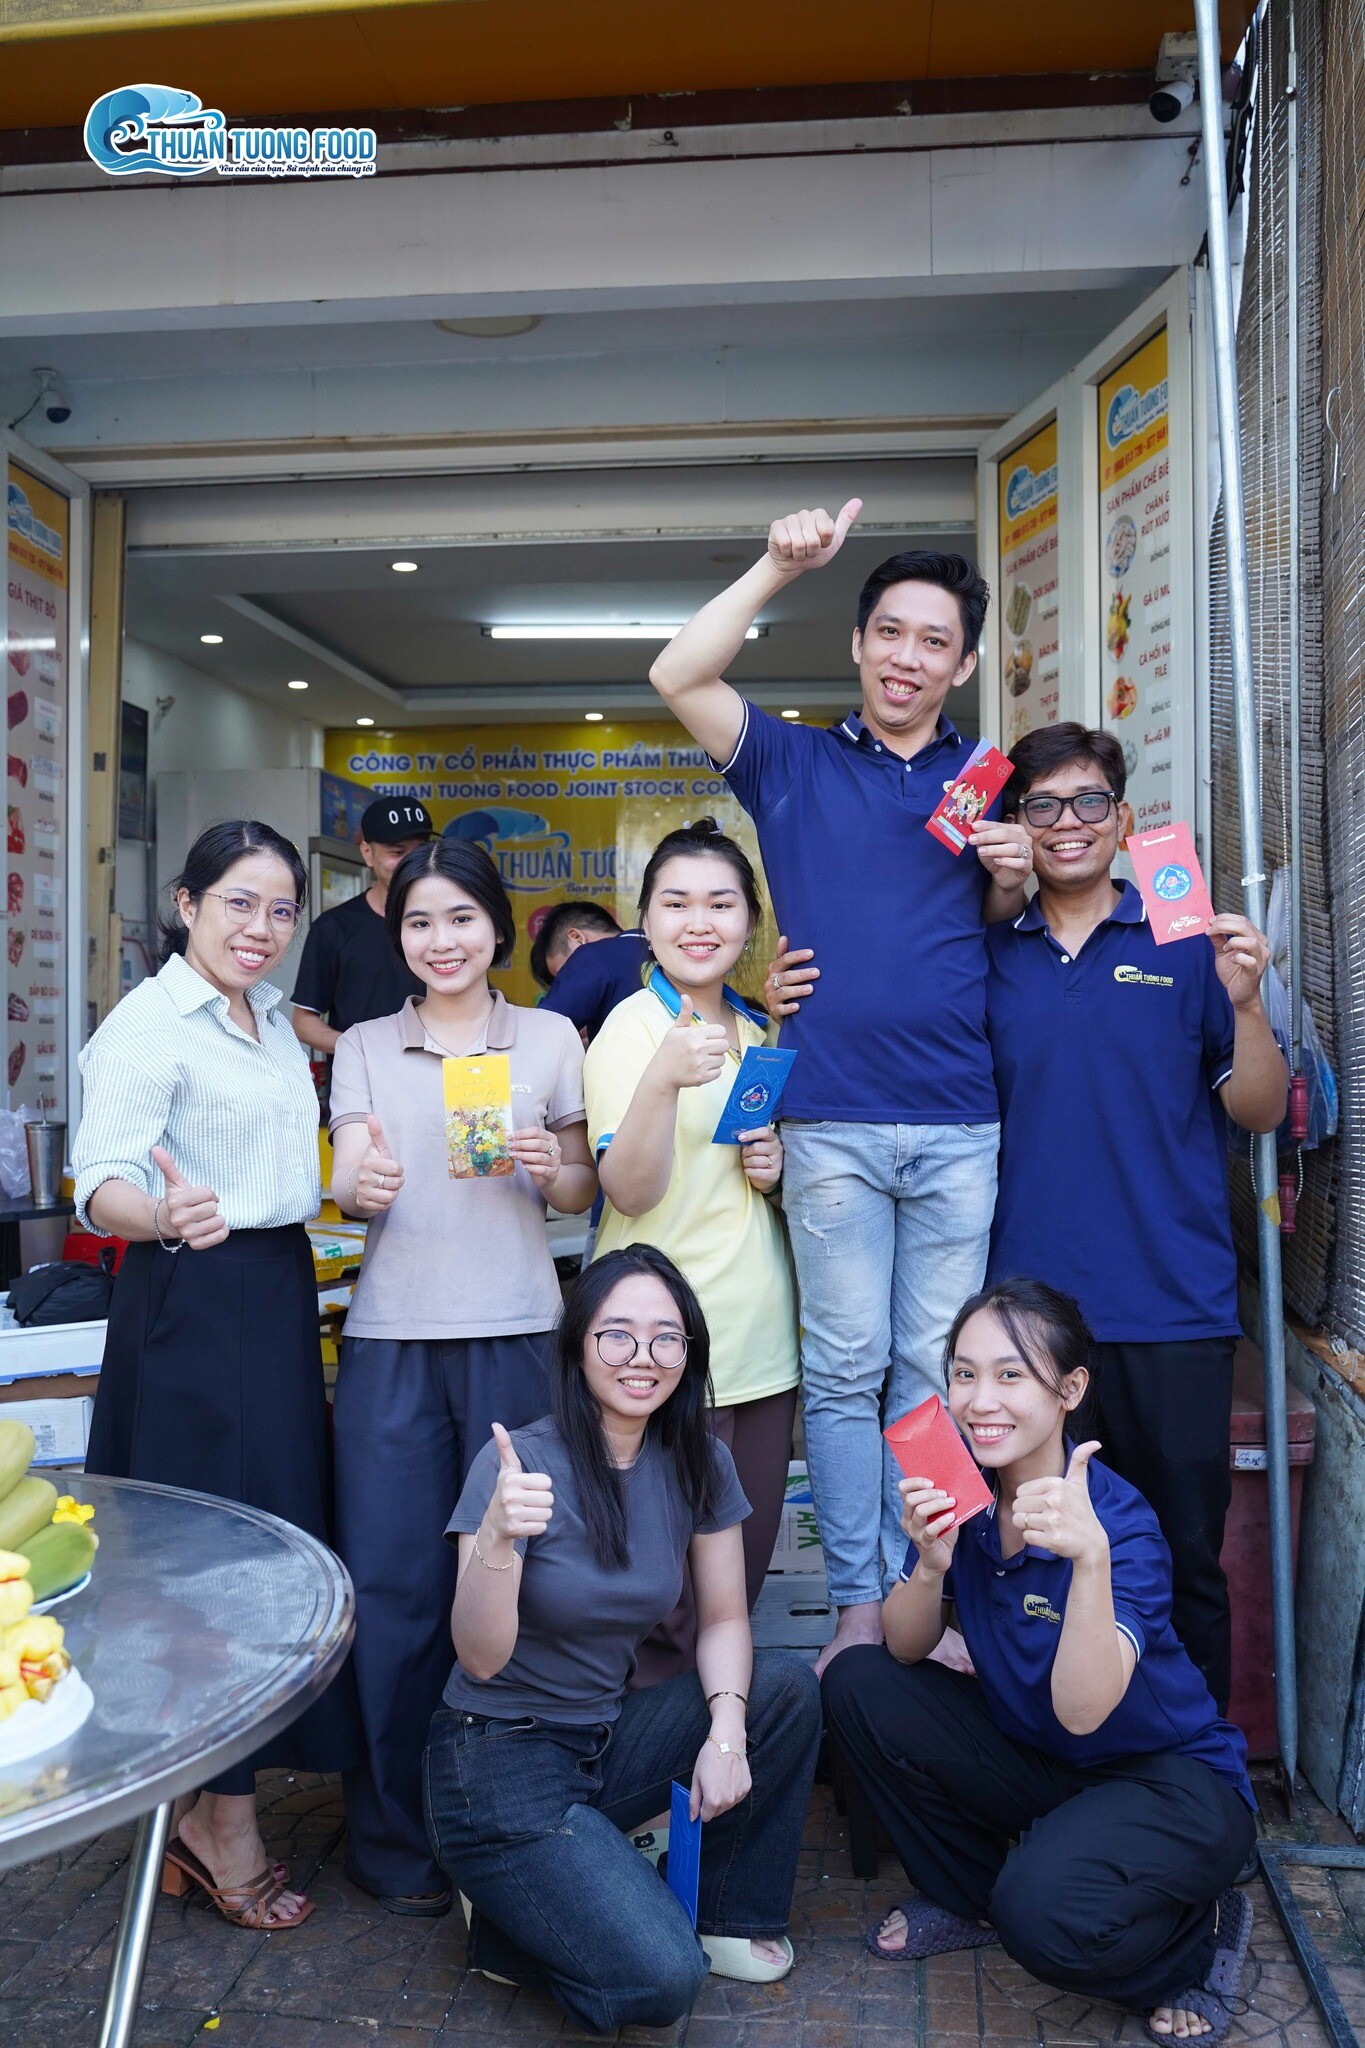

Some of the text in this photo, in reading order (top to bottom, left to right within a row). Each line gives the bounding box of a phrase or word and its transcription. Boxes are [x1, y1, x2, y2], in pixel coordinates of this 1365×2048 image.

[350, 752, 412, 772] CÔNG
[417, 755, 438, 771] TY
[445, 746, 475, 771] CỔ
[543, 749, 596, 773] THỰC
[602, 743, 661, 768] PHẨM
[667, 751, 709, 768] THU
[438, 783, 501, 798] TUONG
[507, 781, 558, 798] FOOD
[565, 780, 618, 797] JOINT
[624, 780, 685, 797] STOCK
[497, 847, 572, 882] THUẬN
